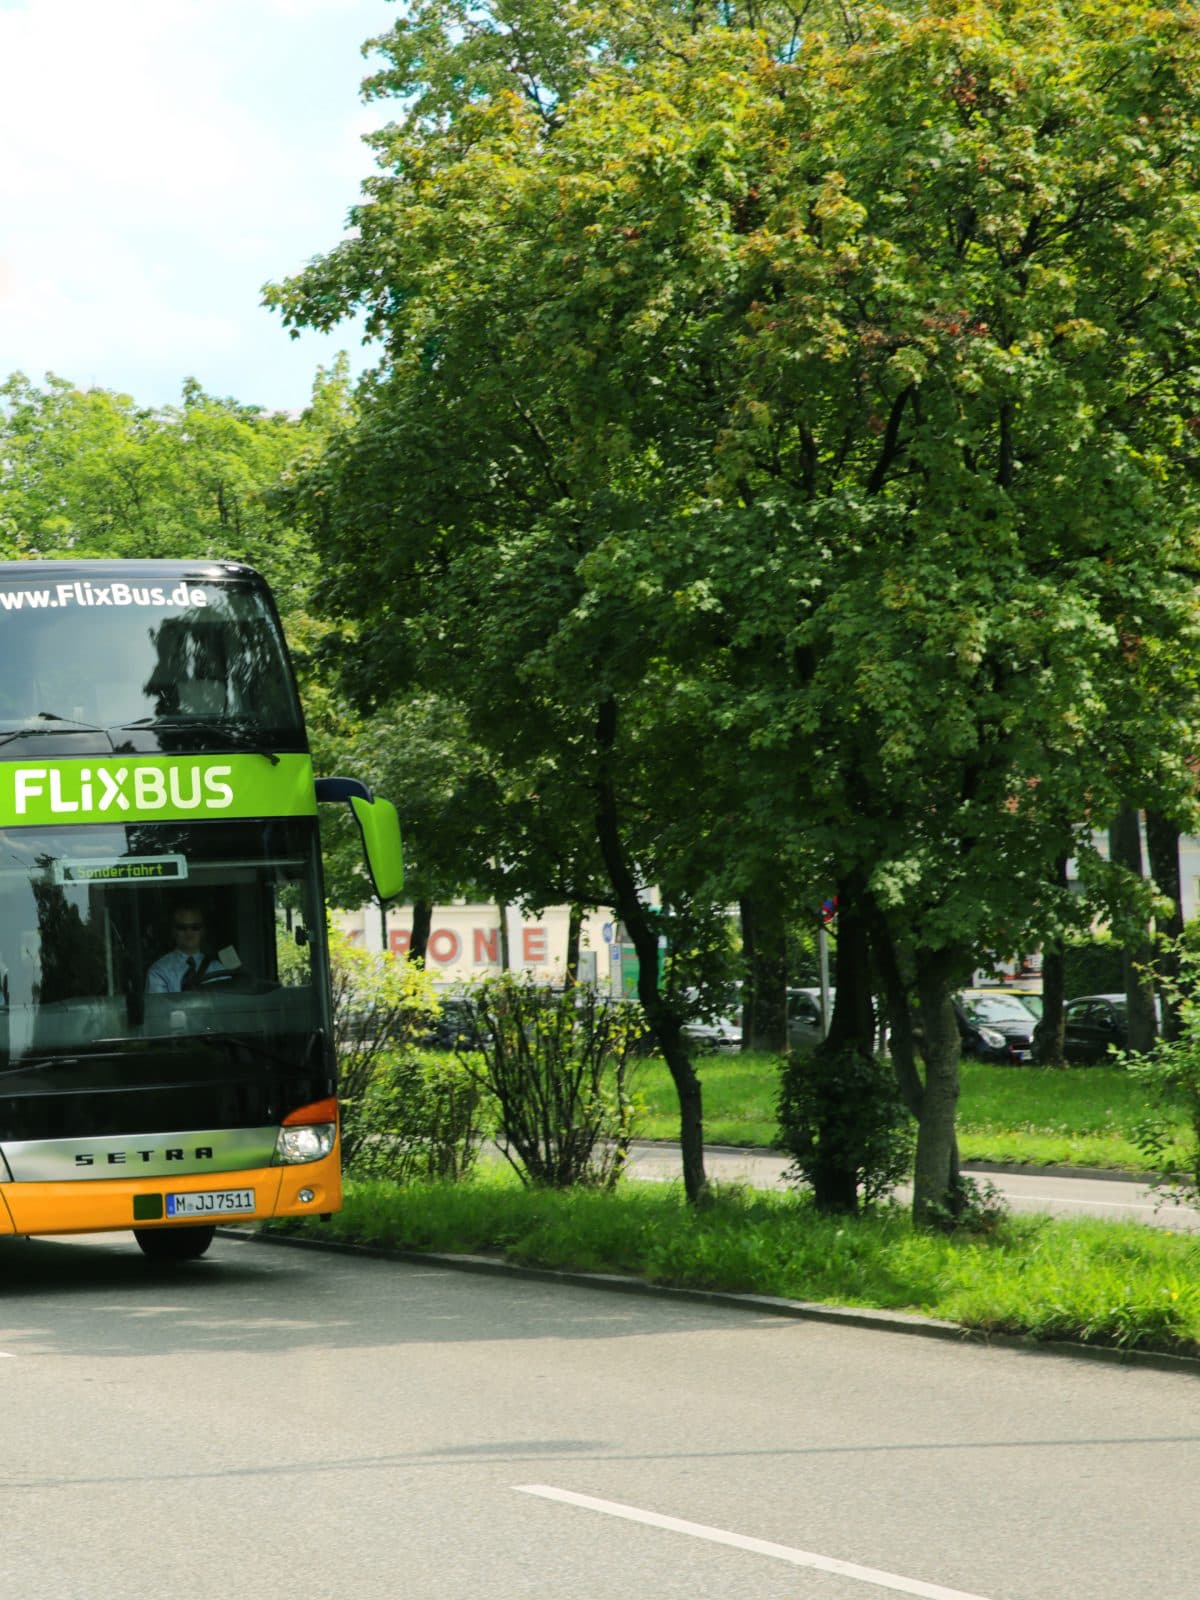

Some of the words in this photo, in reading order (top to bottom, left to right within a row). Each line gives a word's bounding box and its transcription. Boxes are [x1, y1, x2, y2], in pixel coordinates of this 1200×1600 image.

[78, 863, 163, 879] Sonderfahrt
[347, 928, 547, 962] RONE
[75, 1147, 213, 1167] SETRA
